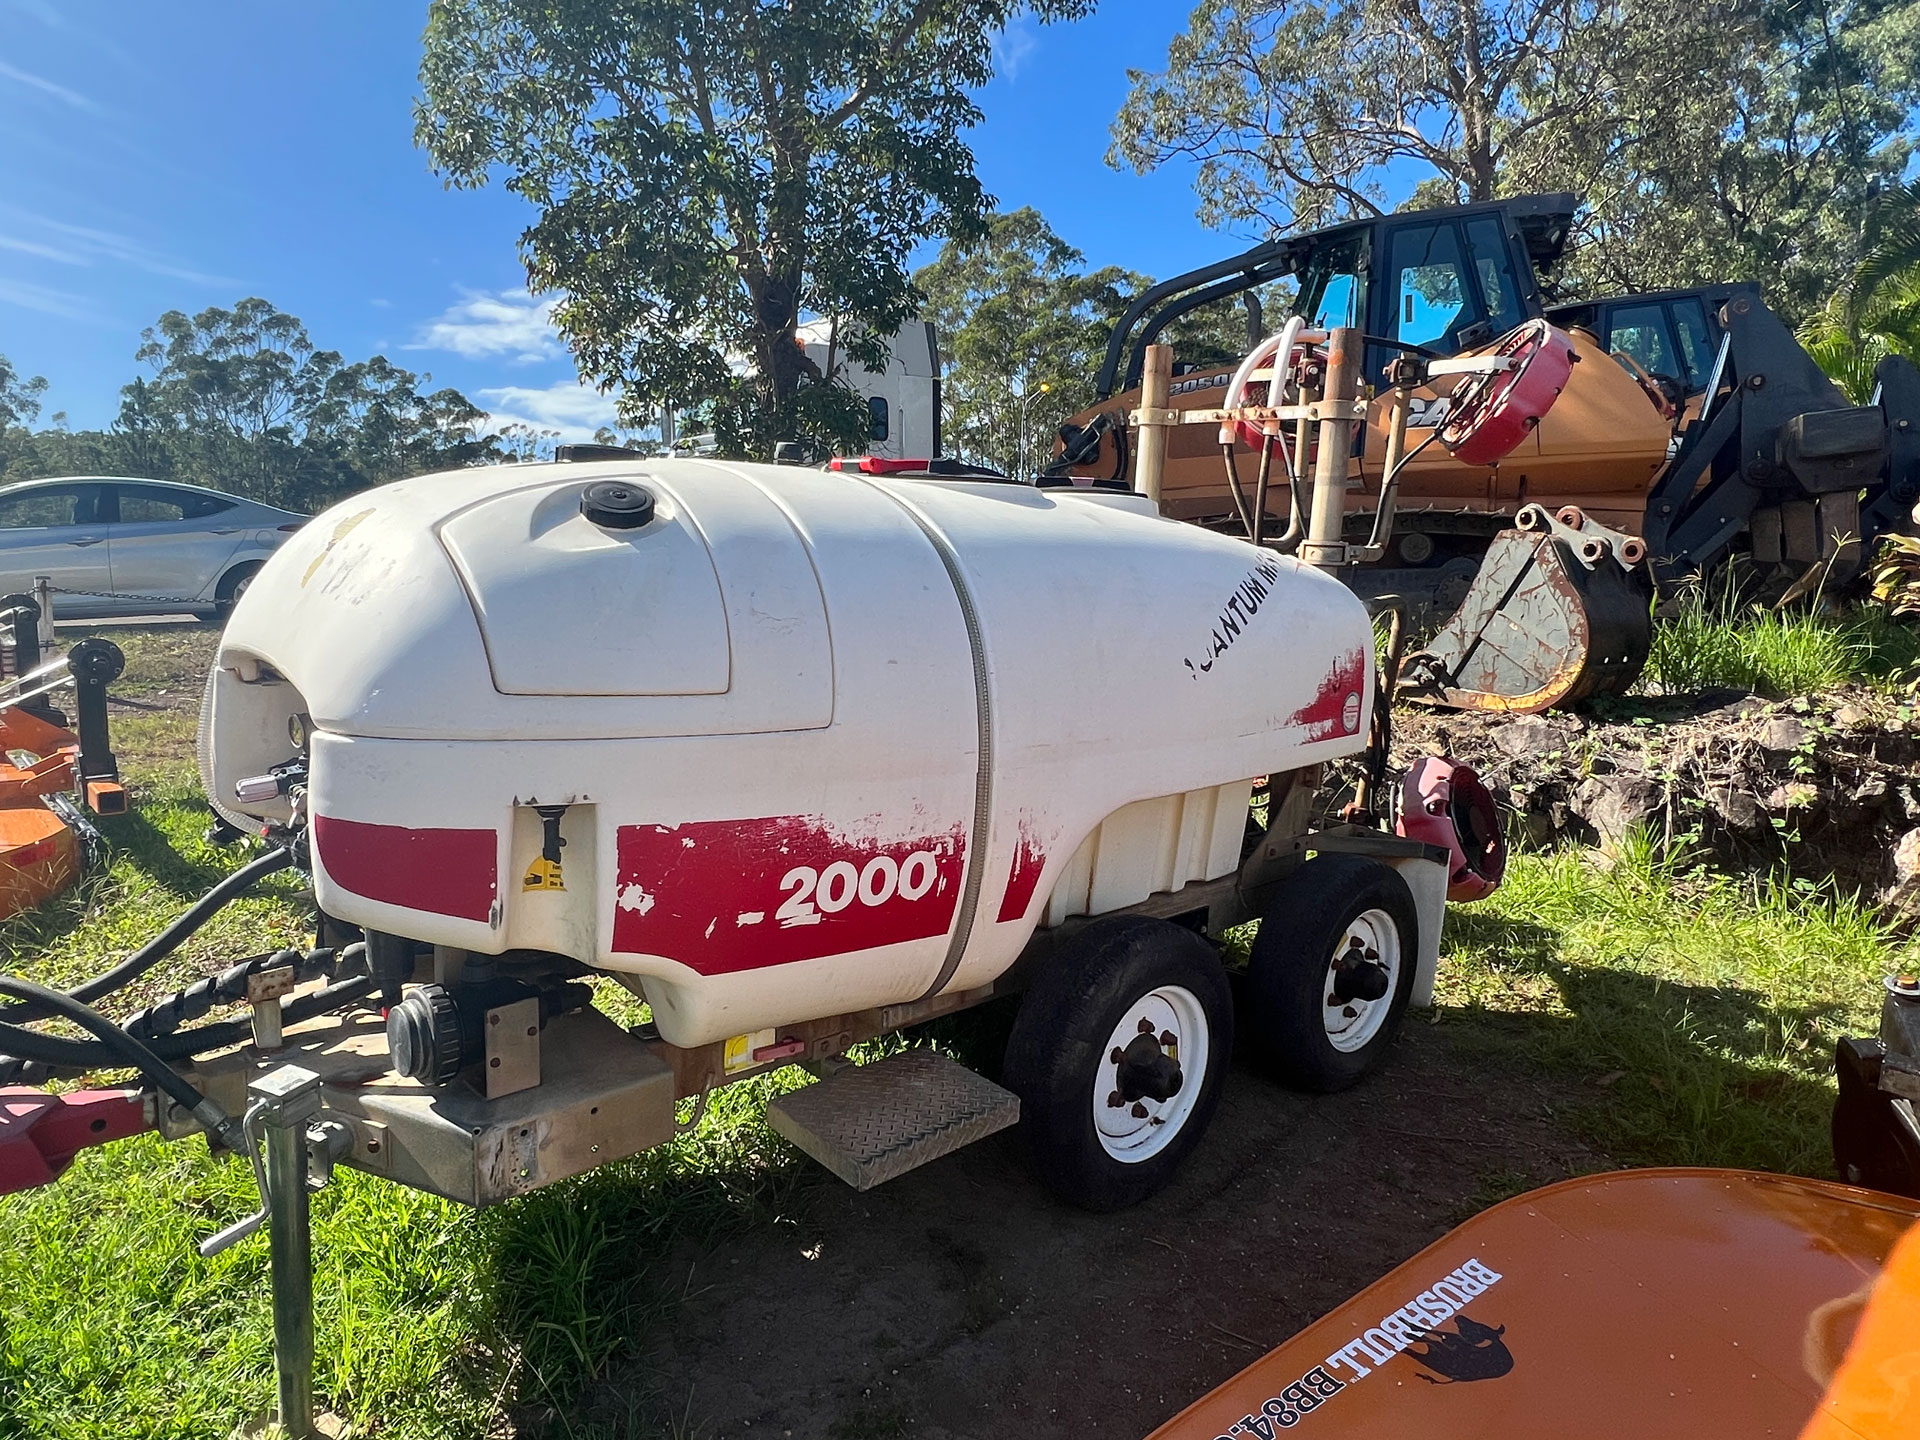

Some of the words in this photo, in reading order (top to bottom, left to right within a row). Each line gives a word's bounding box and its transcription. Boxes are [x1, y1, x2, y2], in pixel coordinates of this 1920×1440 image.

[1169, 372, 1236, 395] 2050
[1390, 397, 1451, 427] CA
[775, 850, 938, 919] 2000
[1325, 1258, 1503, 1379] BRUSHBULL
